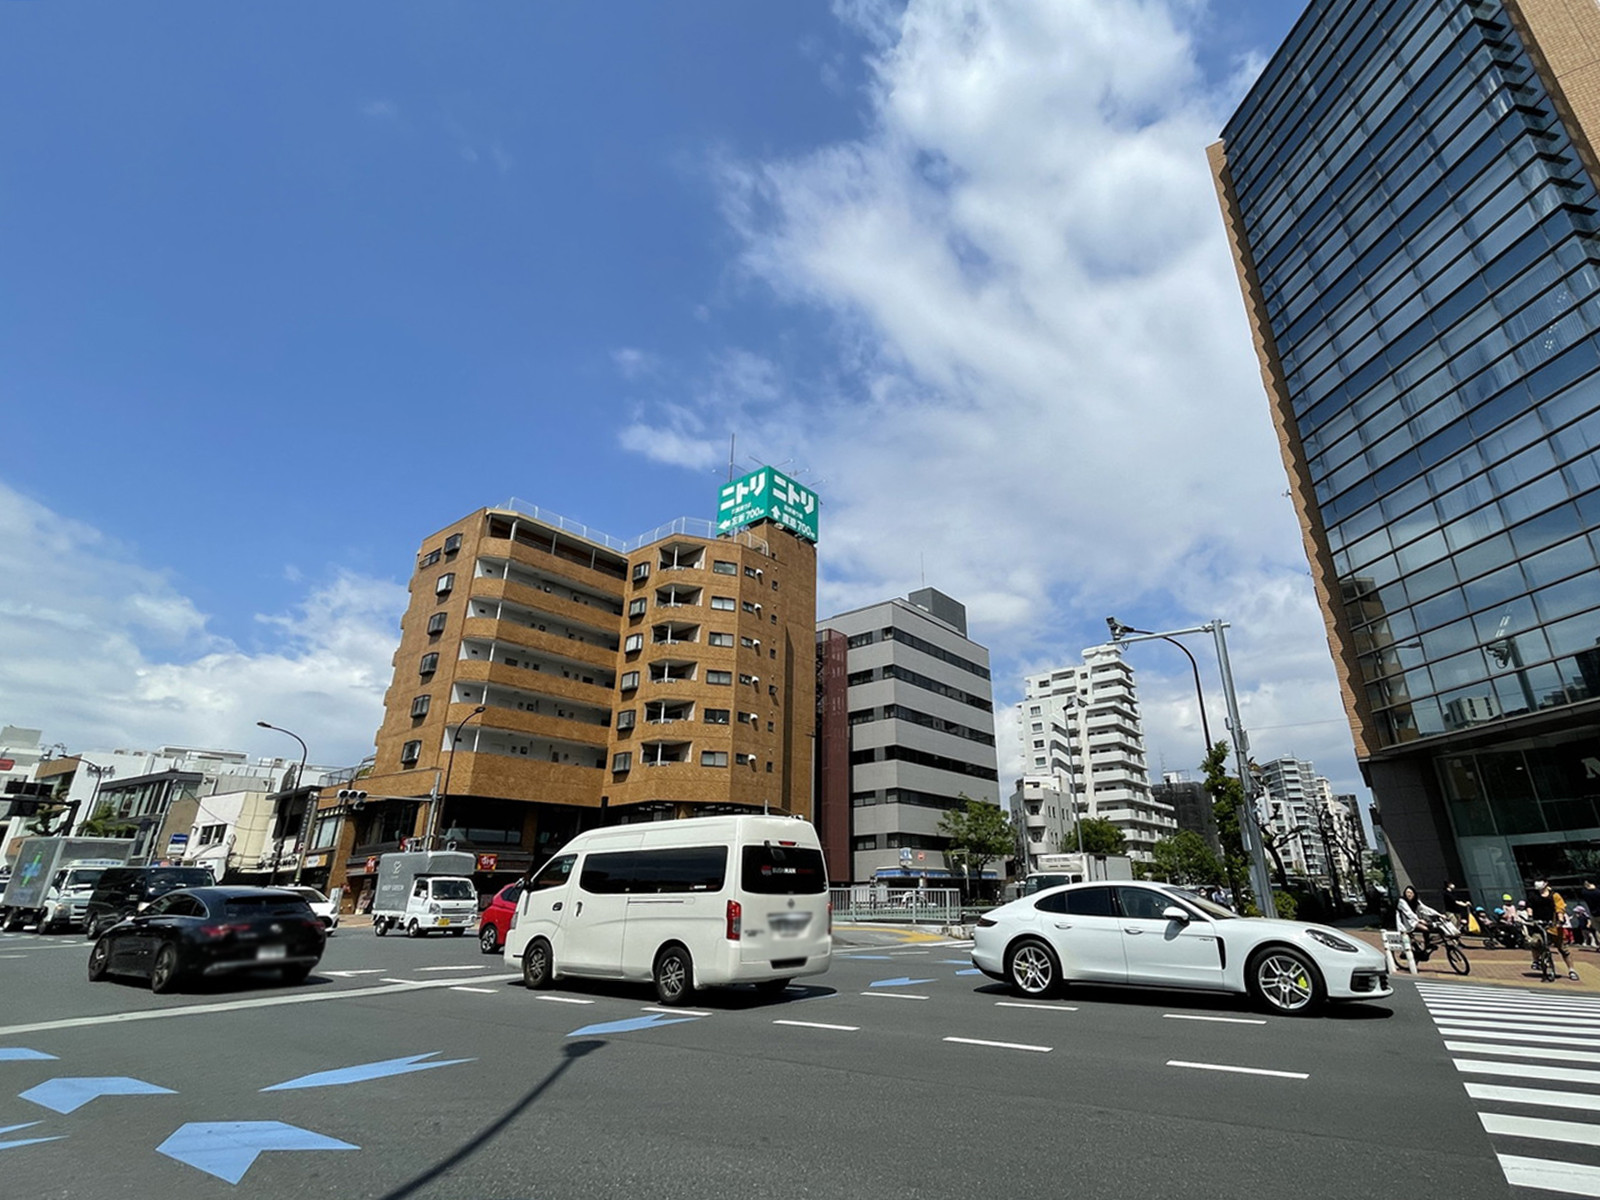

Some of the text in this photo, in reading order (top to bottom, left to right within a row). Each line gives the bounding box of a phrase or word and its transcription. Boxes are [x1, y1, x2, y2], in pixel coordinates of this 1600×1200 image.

[720, 472, 765, 511] ニトリ
[772, 474, 815, 514] ニトリ
